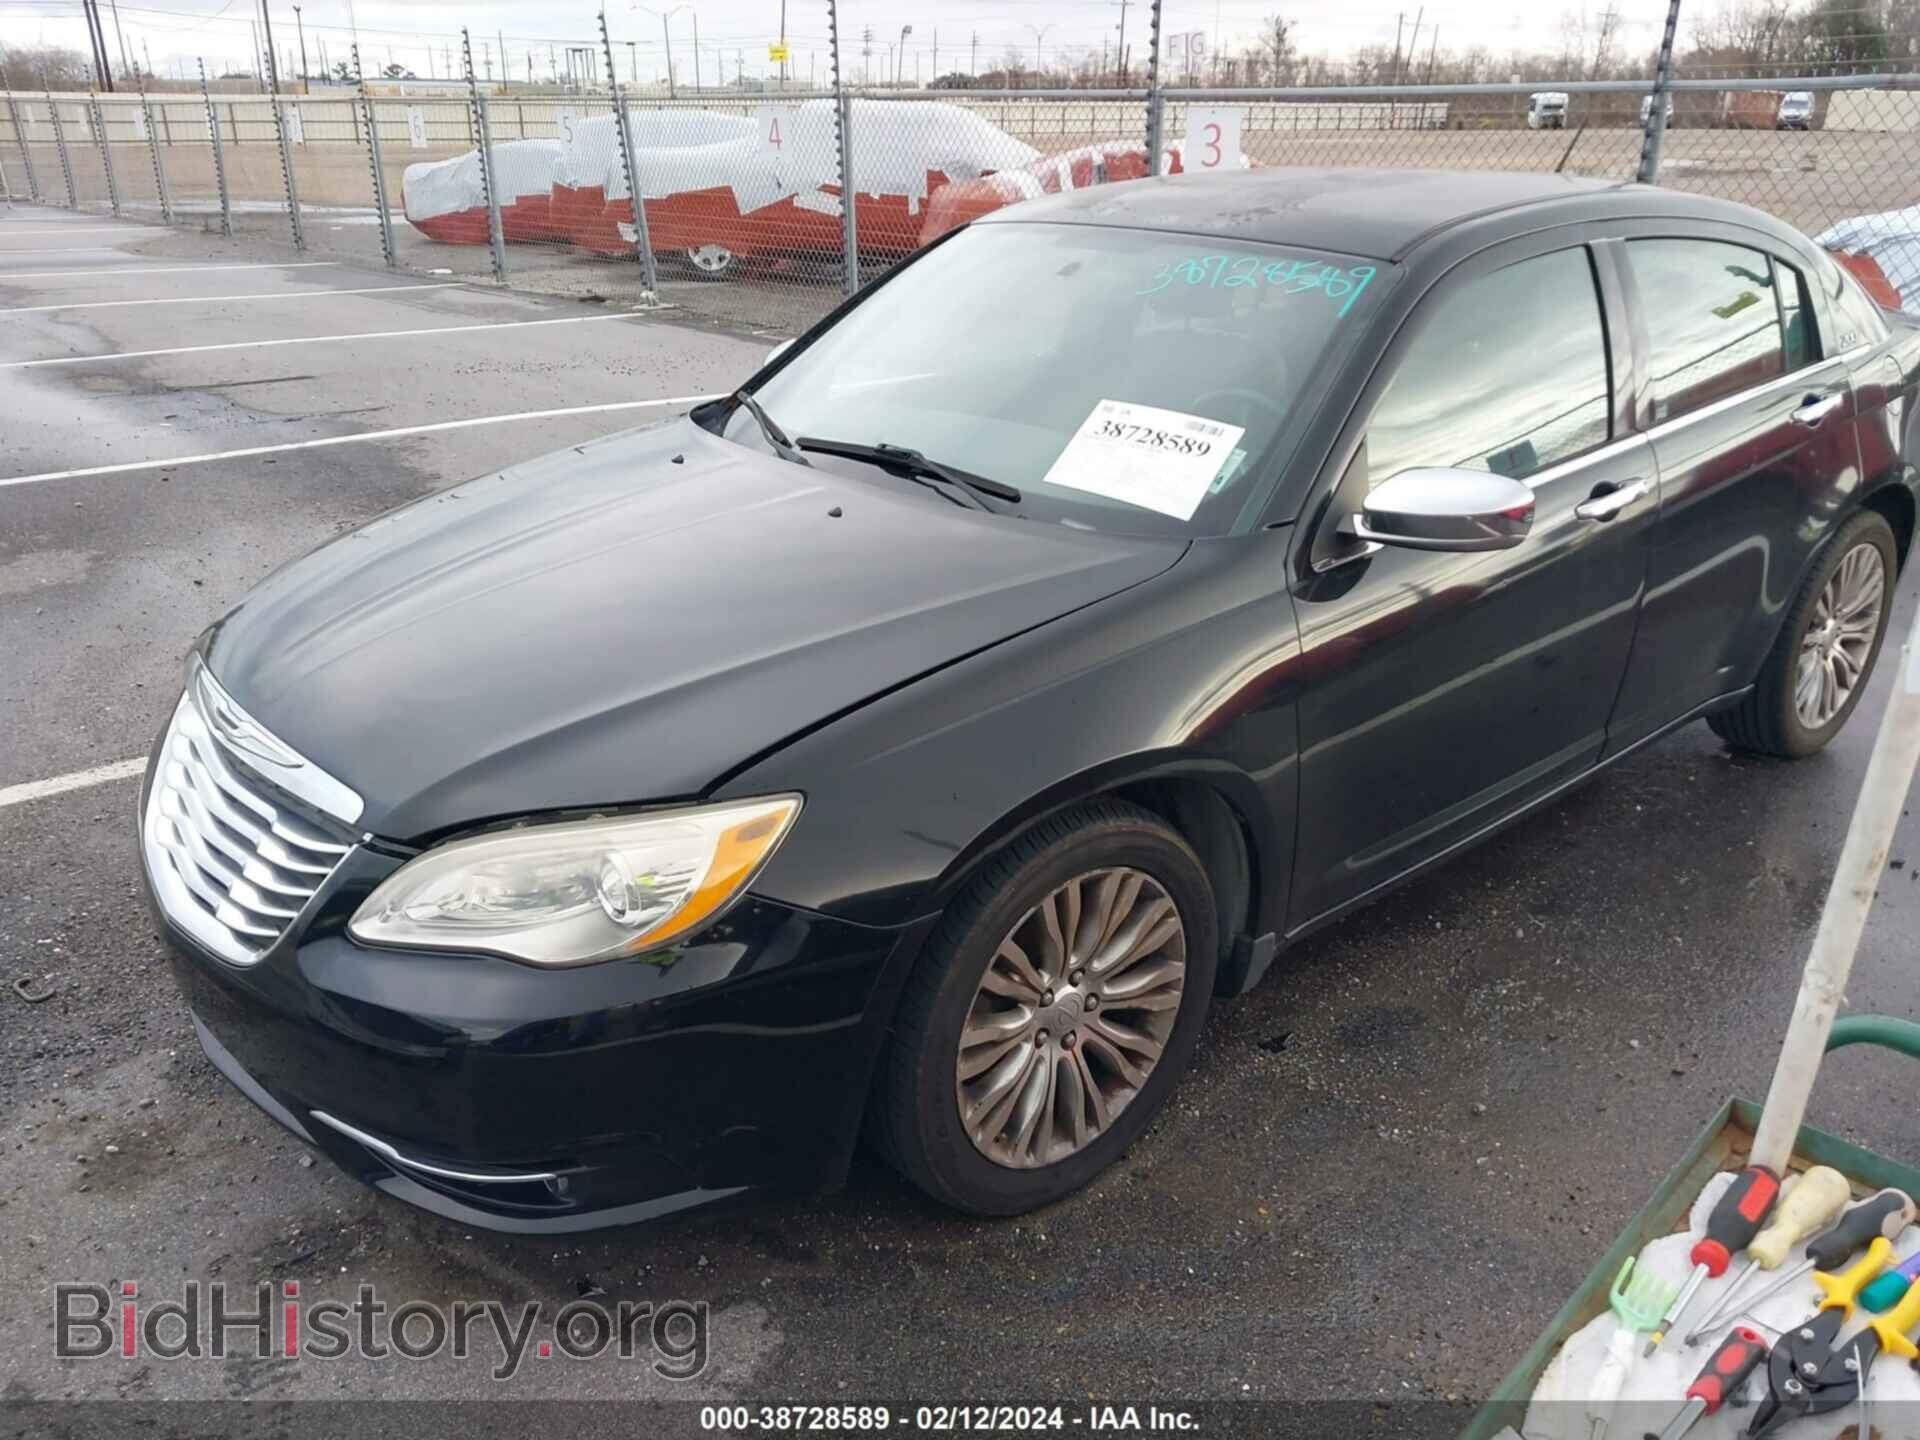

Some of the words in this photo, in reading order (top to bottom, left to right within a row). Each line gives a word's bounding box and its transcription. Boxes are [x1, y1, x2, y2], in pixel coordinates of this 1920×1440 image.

[768, 117, 783, 151] 4
[1202, 123, 1221, 167] 3
[1136, 255, 1377, 319] 38728589
[1094, 420, 1211, 457] 38728589
